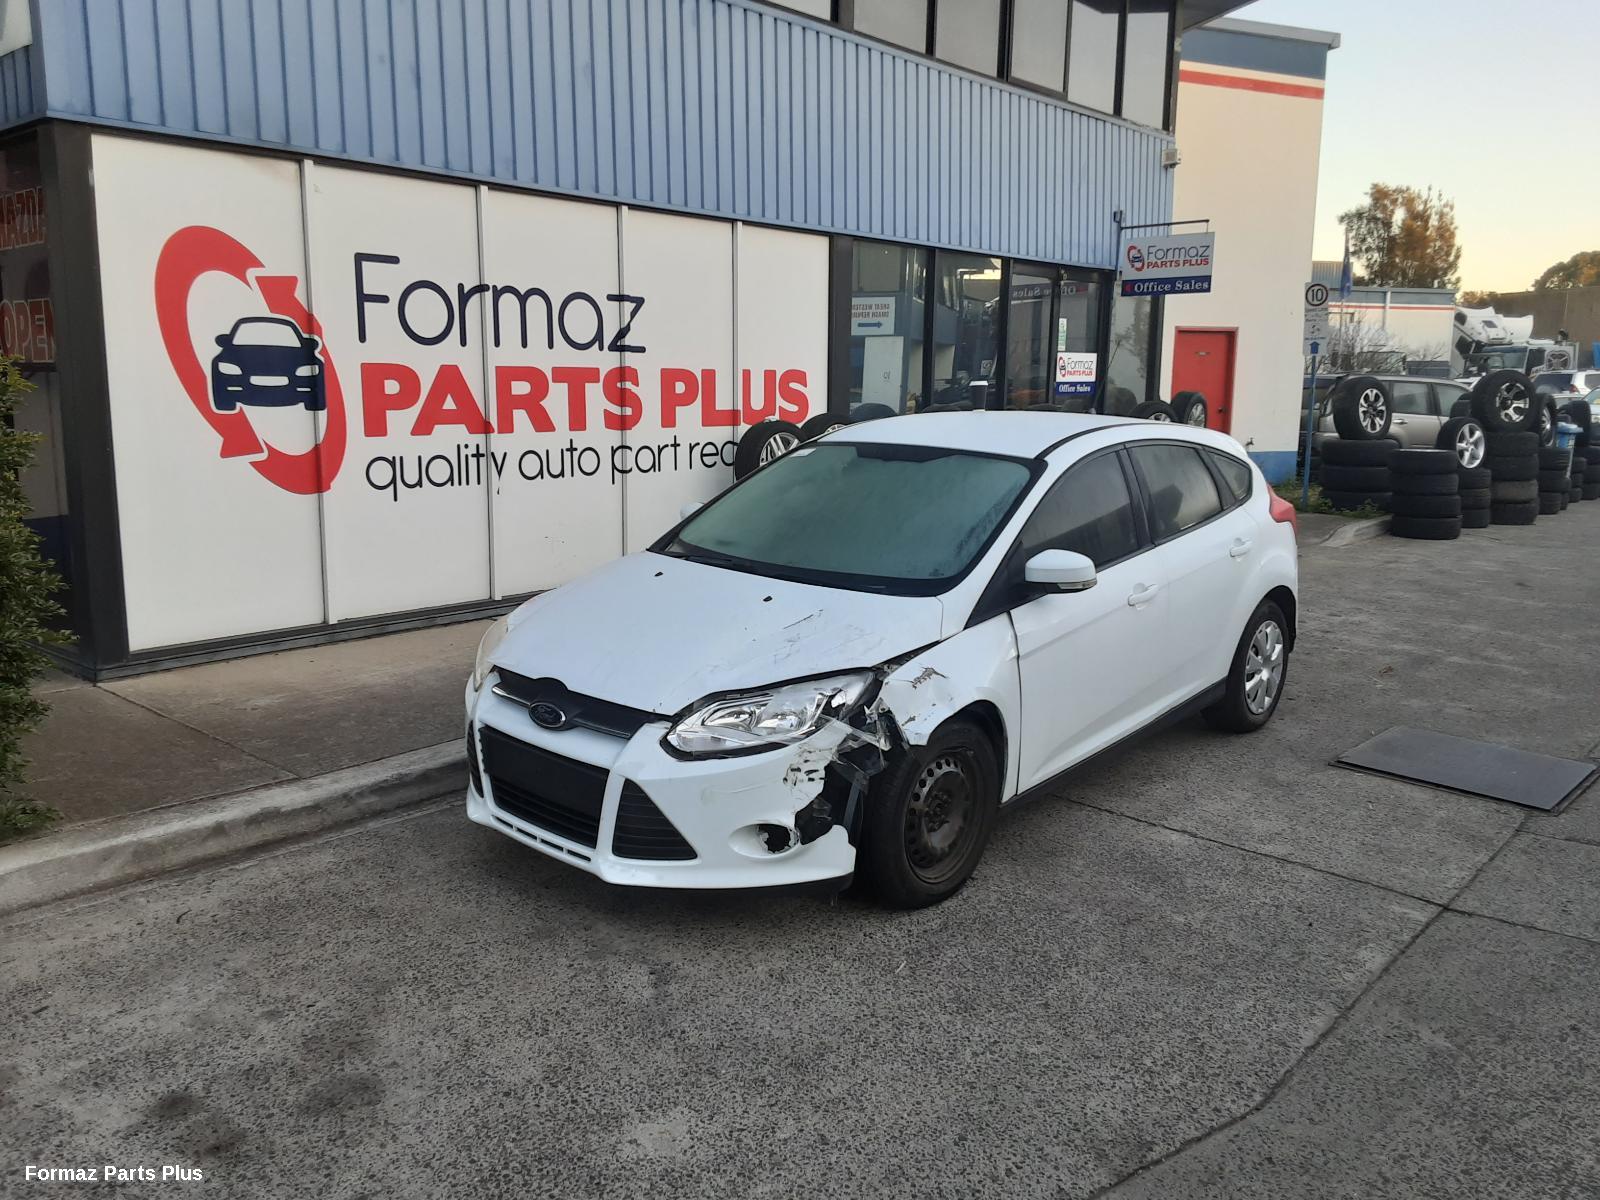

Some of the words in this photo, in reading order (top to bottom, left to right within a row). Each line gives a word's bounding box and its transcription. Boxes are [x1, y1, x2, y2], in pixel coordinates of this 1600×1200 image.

[1147, 245, 1210, 261] Formaz
[1147, 259, 1181, 269] PARTS
[1182, 257, 1210, 267] PLUS
[1134, 282, 1172, 293] Office
[1174, 280, 1209, 291] Sales
[354, 252, 646, 353] Formaz
[1311, 288, 1324, 302] 10
[1066, 358, 1094, 370] Formaz
[360, 362, 643, 437] PARTS
[660, 368, 809, 428] PLUS
[365, 443, 508, 502] quality
[518, 438, 601, 481] auto
[610, 434, 681, 485] part
